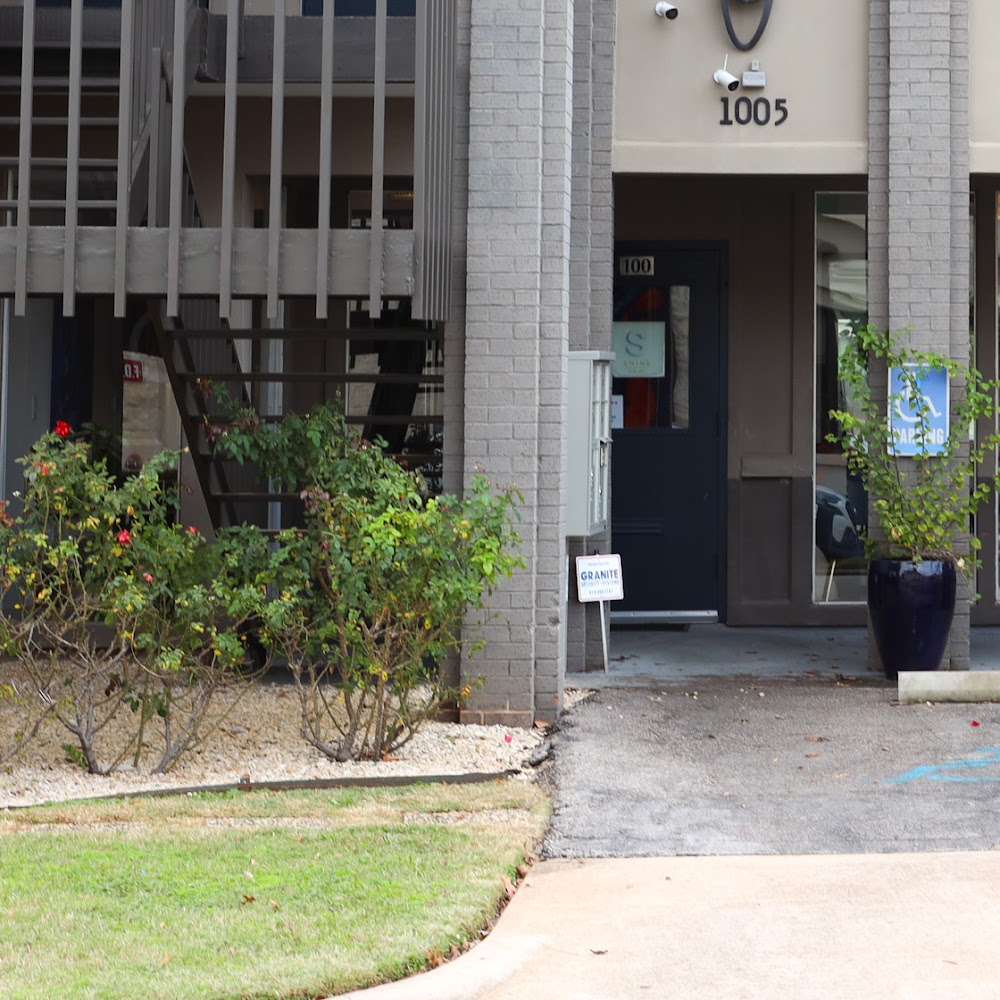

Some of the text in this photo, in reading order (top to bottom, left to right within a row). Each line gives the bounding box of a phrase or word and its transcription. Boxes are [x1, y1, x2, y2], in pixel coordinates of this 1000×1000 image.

[719, 96, 789, 126] 1005
[623, 258, 651, 273] 100
[581, 569, 618, 580] GRANITE
